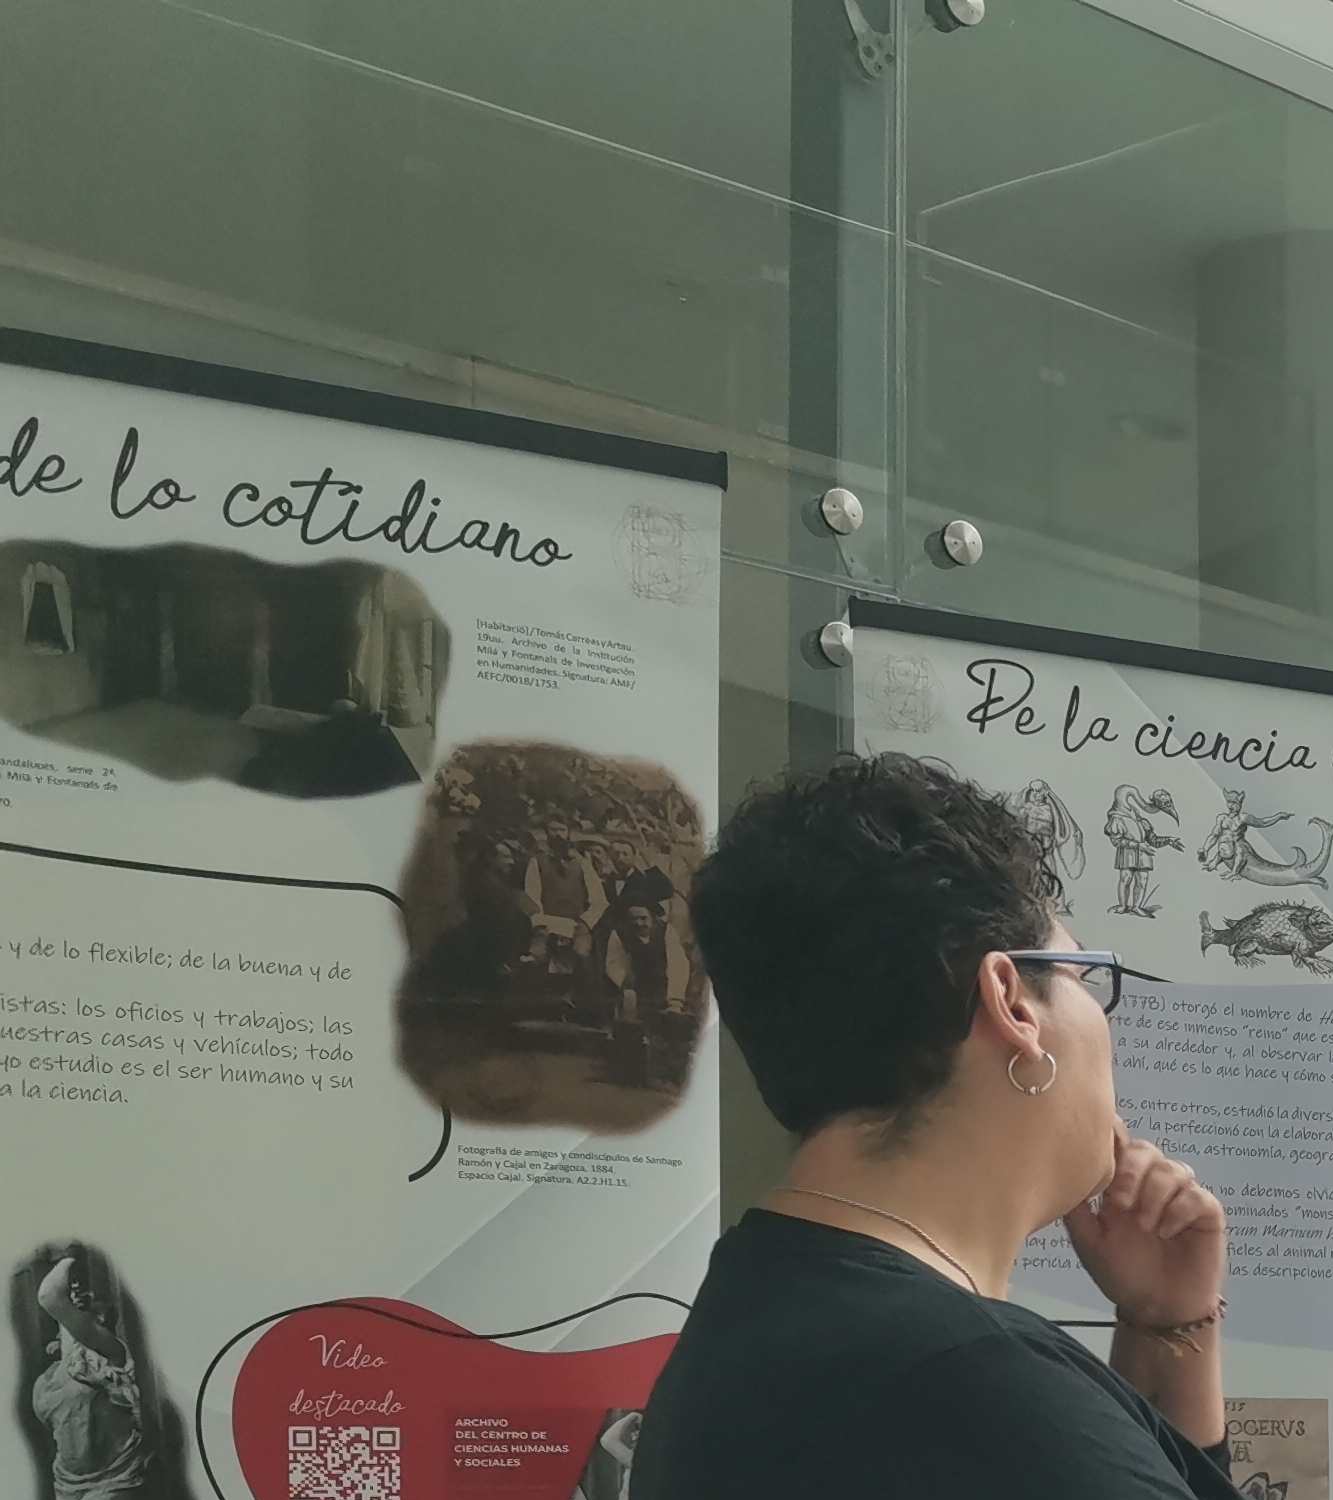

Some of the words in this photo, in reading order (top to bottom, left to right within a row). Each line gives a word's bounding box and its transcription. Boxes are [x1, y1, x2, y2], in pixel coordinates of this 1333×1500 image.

[0, 416, 82, 496] de
[110, 428, 196, 519] lo
[222, 467, 573, 568] cotidiano
[966, 658, 1045, 736] De
[1062, 685, 1119, 753] la
[1134, 714, 1318, 771] ciencia
[9, 941, 21, 959] y
[28, 937, 55, 957] de
[64, 940, 80, 959] lo
[89, 943, 173, 969] flexible;
[180, 949, 205, 968] de
[212, 952, 231, 971] la
[239, 955, 302, 977] buena
[310, 966, 321, 982] y
[328, 962, 352, 980] de
[1172, 999, 1218, 1020] otorgó
[1223, 1003, 1235, 1015] el
[1240, 1006, 1292, 1021] nombre
[1297, 1007, 1312, 1023] de
[29, 1054, 113, 1075] estudio
[121, 1061, 145, 1076] es
[153, 1060, 170, 1078] el
[178, 1065, 213, 1080] ser
[220, 1063, 305, 1087] humano
[312, 1074, 322, 1091] y
[330, 1073, 353, 1089] su
[0, 1083, 12, 1098] a
[21, 1079, 42, 1099] la
[49, 1082, 129, 1103] ciencia.
[1267, 1245, 1280, 1257] al
[1283, 1246, 1327, 1260] animal
[1229, 1262, 1249, 1276] las
[289, 1389, 406, 1421] destacado
[455, 1418, 508, 1427] ARCHIVO
[455, 1430, 478, 1439] DEL
[481, 1431, 528, 1440] CENTRO
[531, 1431, 547, 1440] DE
[454, 1445, 508, 1453] CIENCIAS
[510, 1445, 570, 1453] HUMANAS
[464, 1459, 521, 1467] SOCIALES
